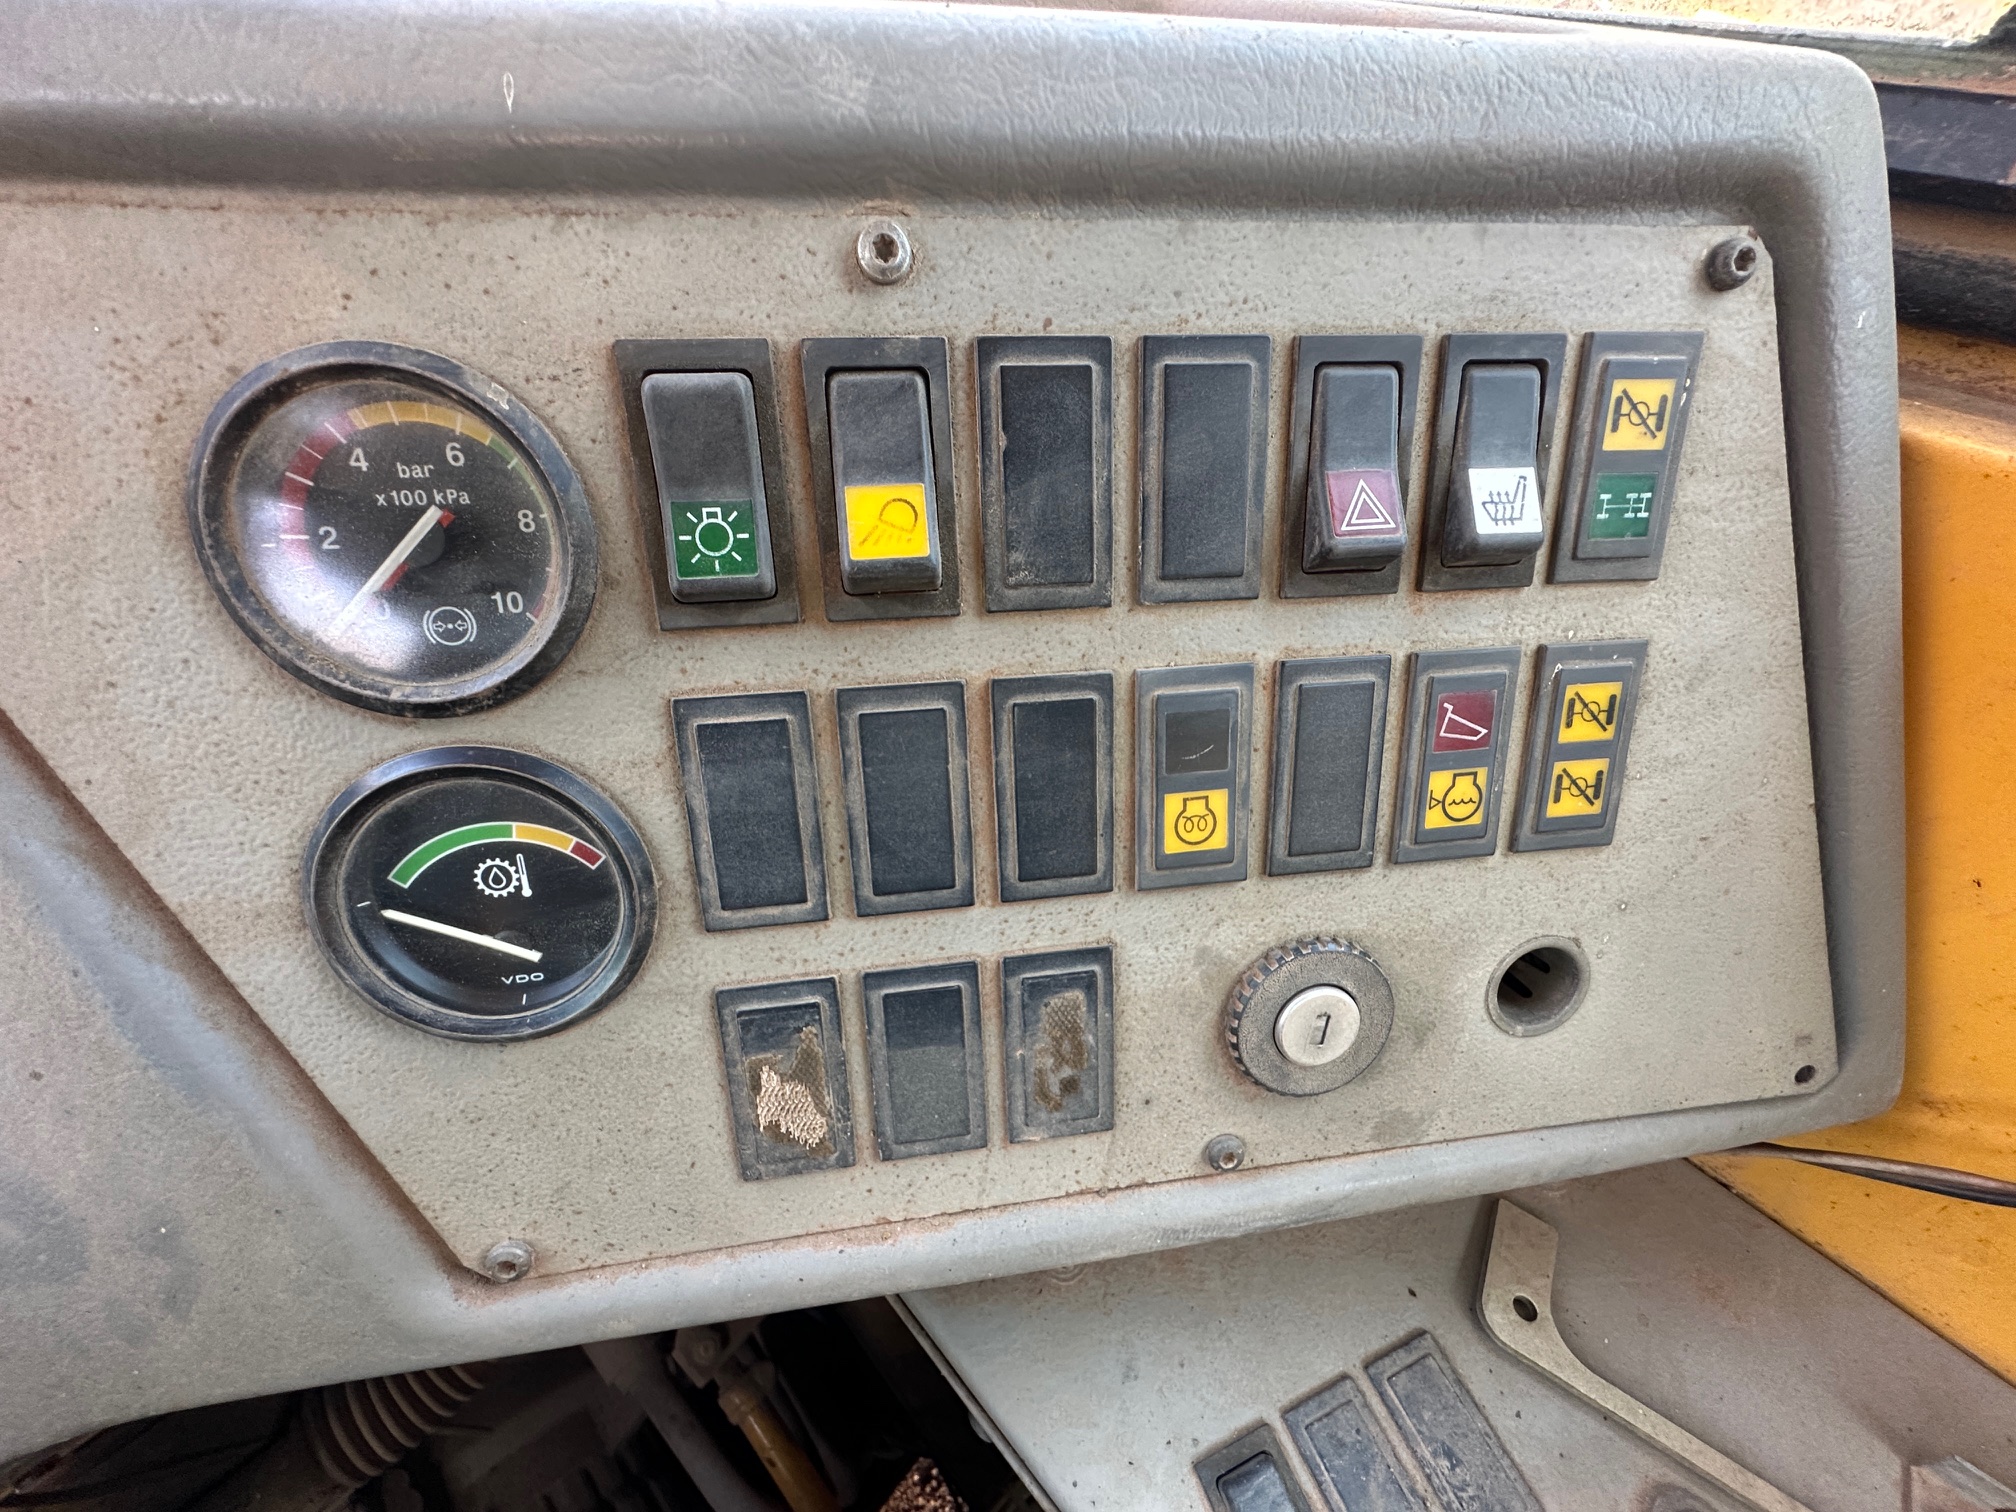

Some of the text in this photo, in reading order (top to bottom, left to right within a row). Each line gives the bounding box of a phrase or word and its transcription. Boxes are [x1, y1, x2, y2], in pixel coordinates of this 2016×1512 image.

[349, 448, 369, 472] 4
[445, 442, 465, 467] 6
[397, 461, 434, 479] bar
[375, 488, 470, 507] x100 kPa
[518, 509, 536, 533] 8
[319, 526, 341, 550] 2
[491, 591, 524, 614] 10
[501, 972, 544, 984] VDO
